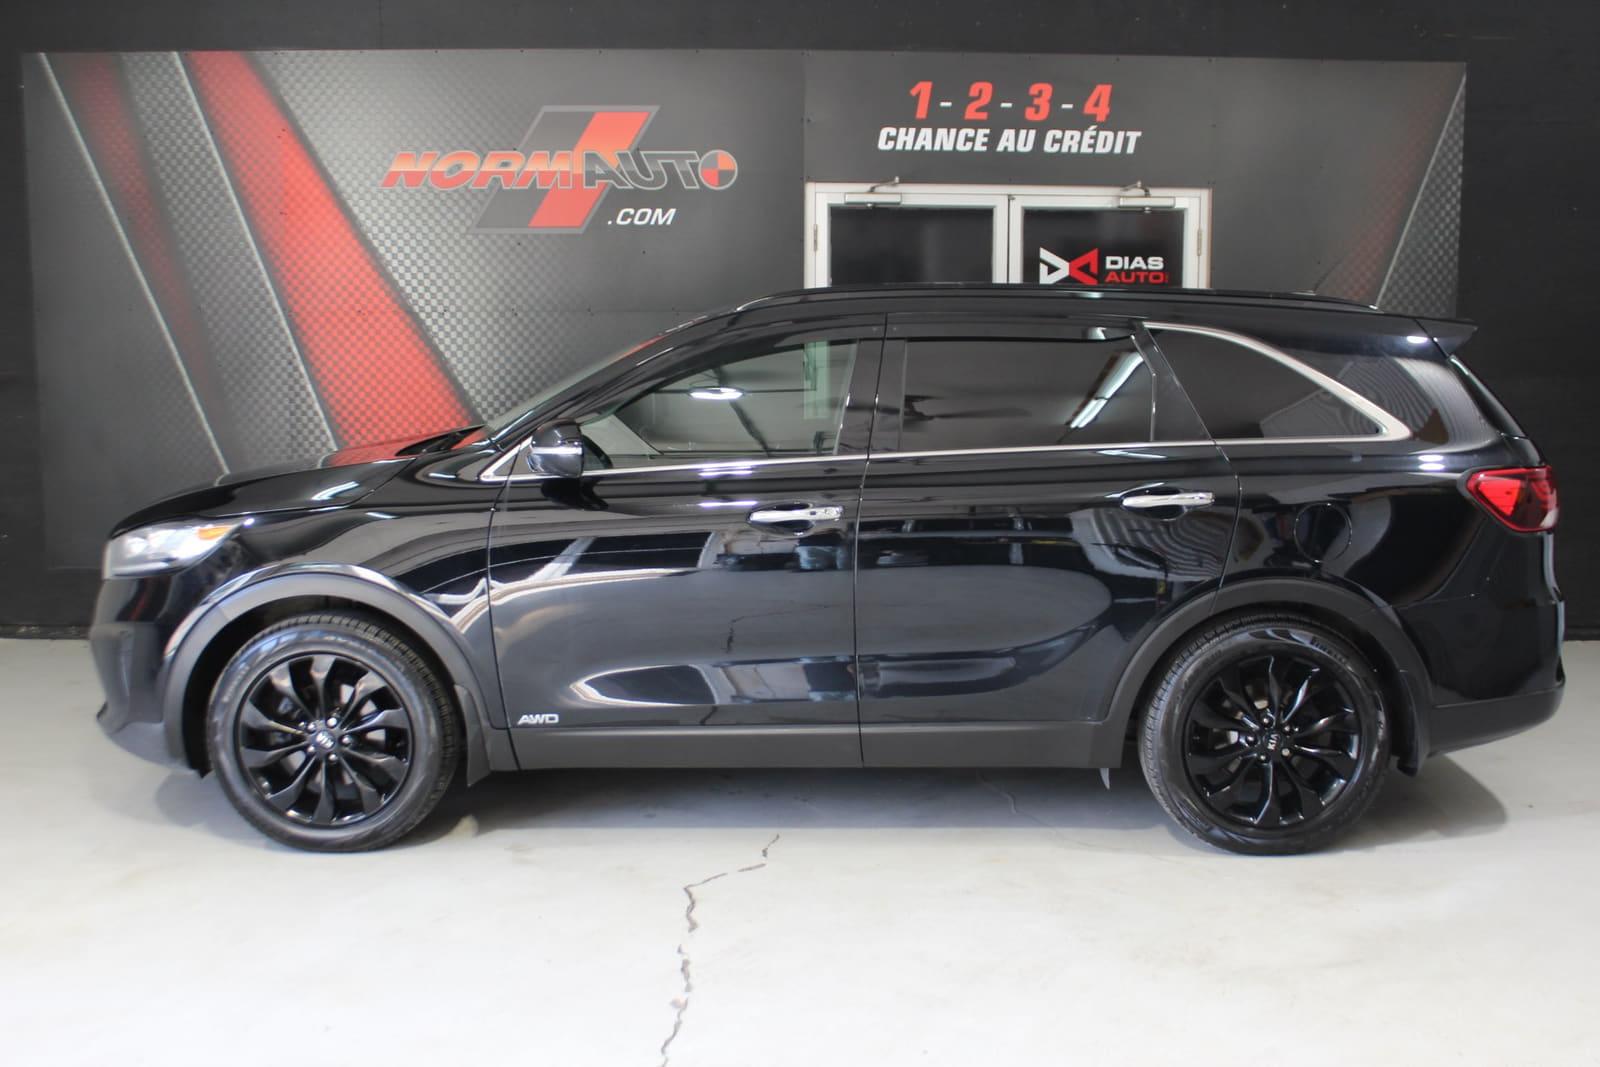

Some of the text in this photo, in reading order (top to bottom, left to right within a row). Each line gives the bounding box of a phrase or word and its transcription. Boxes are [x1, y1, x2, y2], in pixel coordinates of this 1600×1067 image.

[877, 125, 1142, 154] CHANCE AU CRÉDIT
[607, 208, 676, 225] .COM
[1105, 256, 1164, 270] DIAS
[1105, 271, 1163, 283] AUTO
[517, 713, 559, 725] AWD
